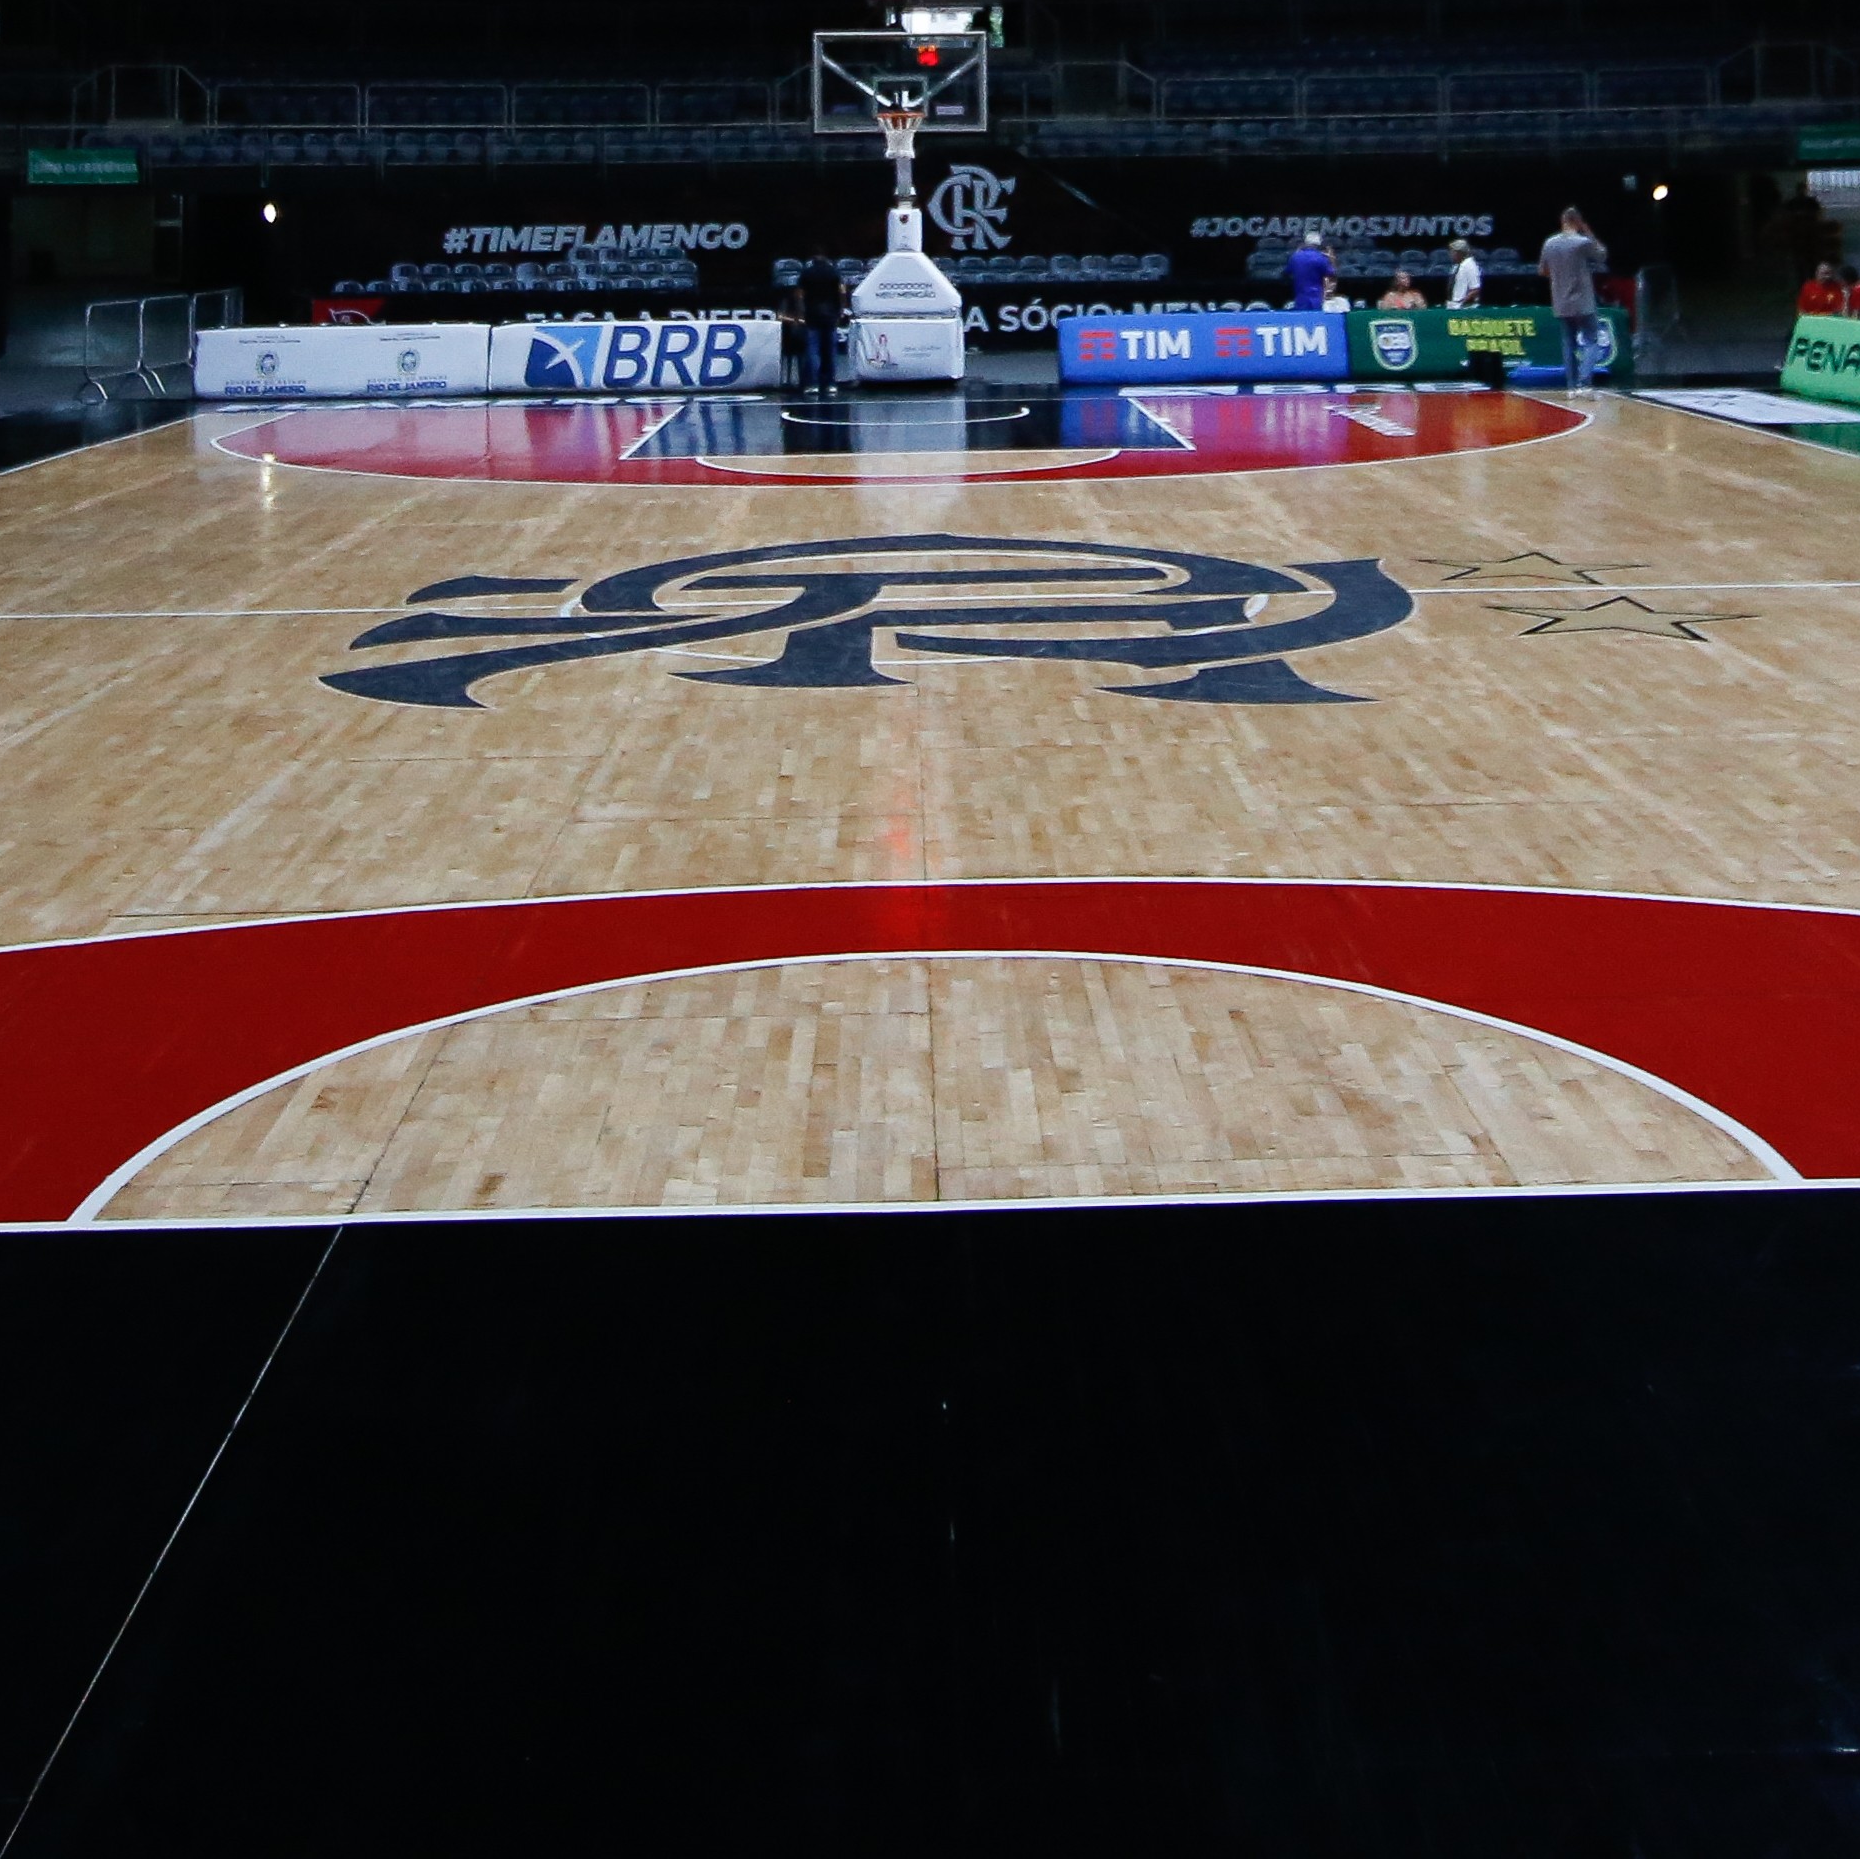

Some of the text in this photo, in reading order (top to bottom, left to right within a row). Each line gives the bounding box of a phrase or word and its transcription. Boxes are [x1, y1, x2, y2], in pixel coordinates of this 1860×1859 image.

[443, 222, 749, 253] #TIMEFLAMENGO
[1190, 214, 1494, 238] #JOGAREMOSJUNTOS
[1255, 325, 1329, 357] TIM
[1448, 318, 1536, 337] BASQUETE
[603, 323, 747, 389] BRB
[1120, 329, 1190, 360] TIM
